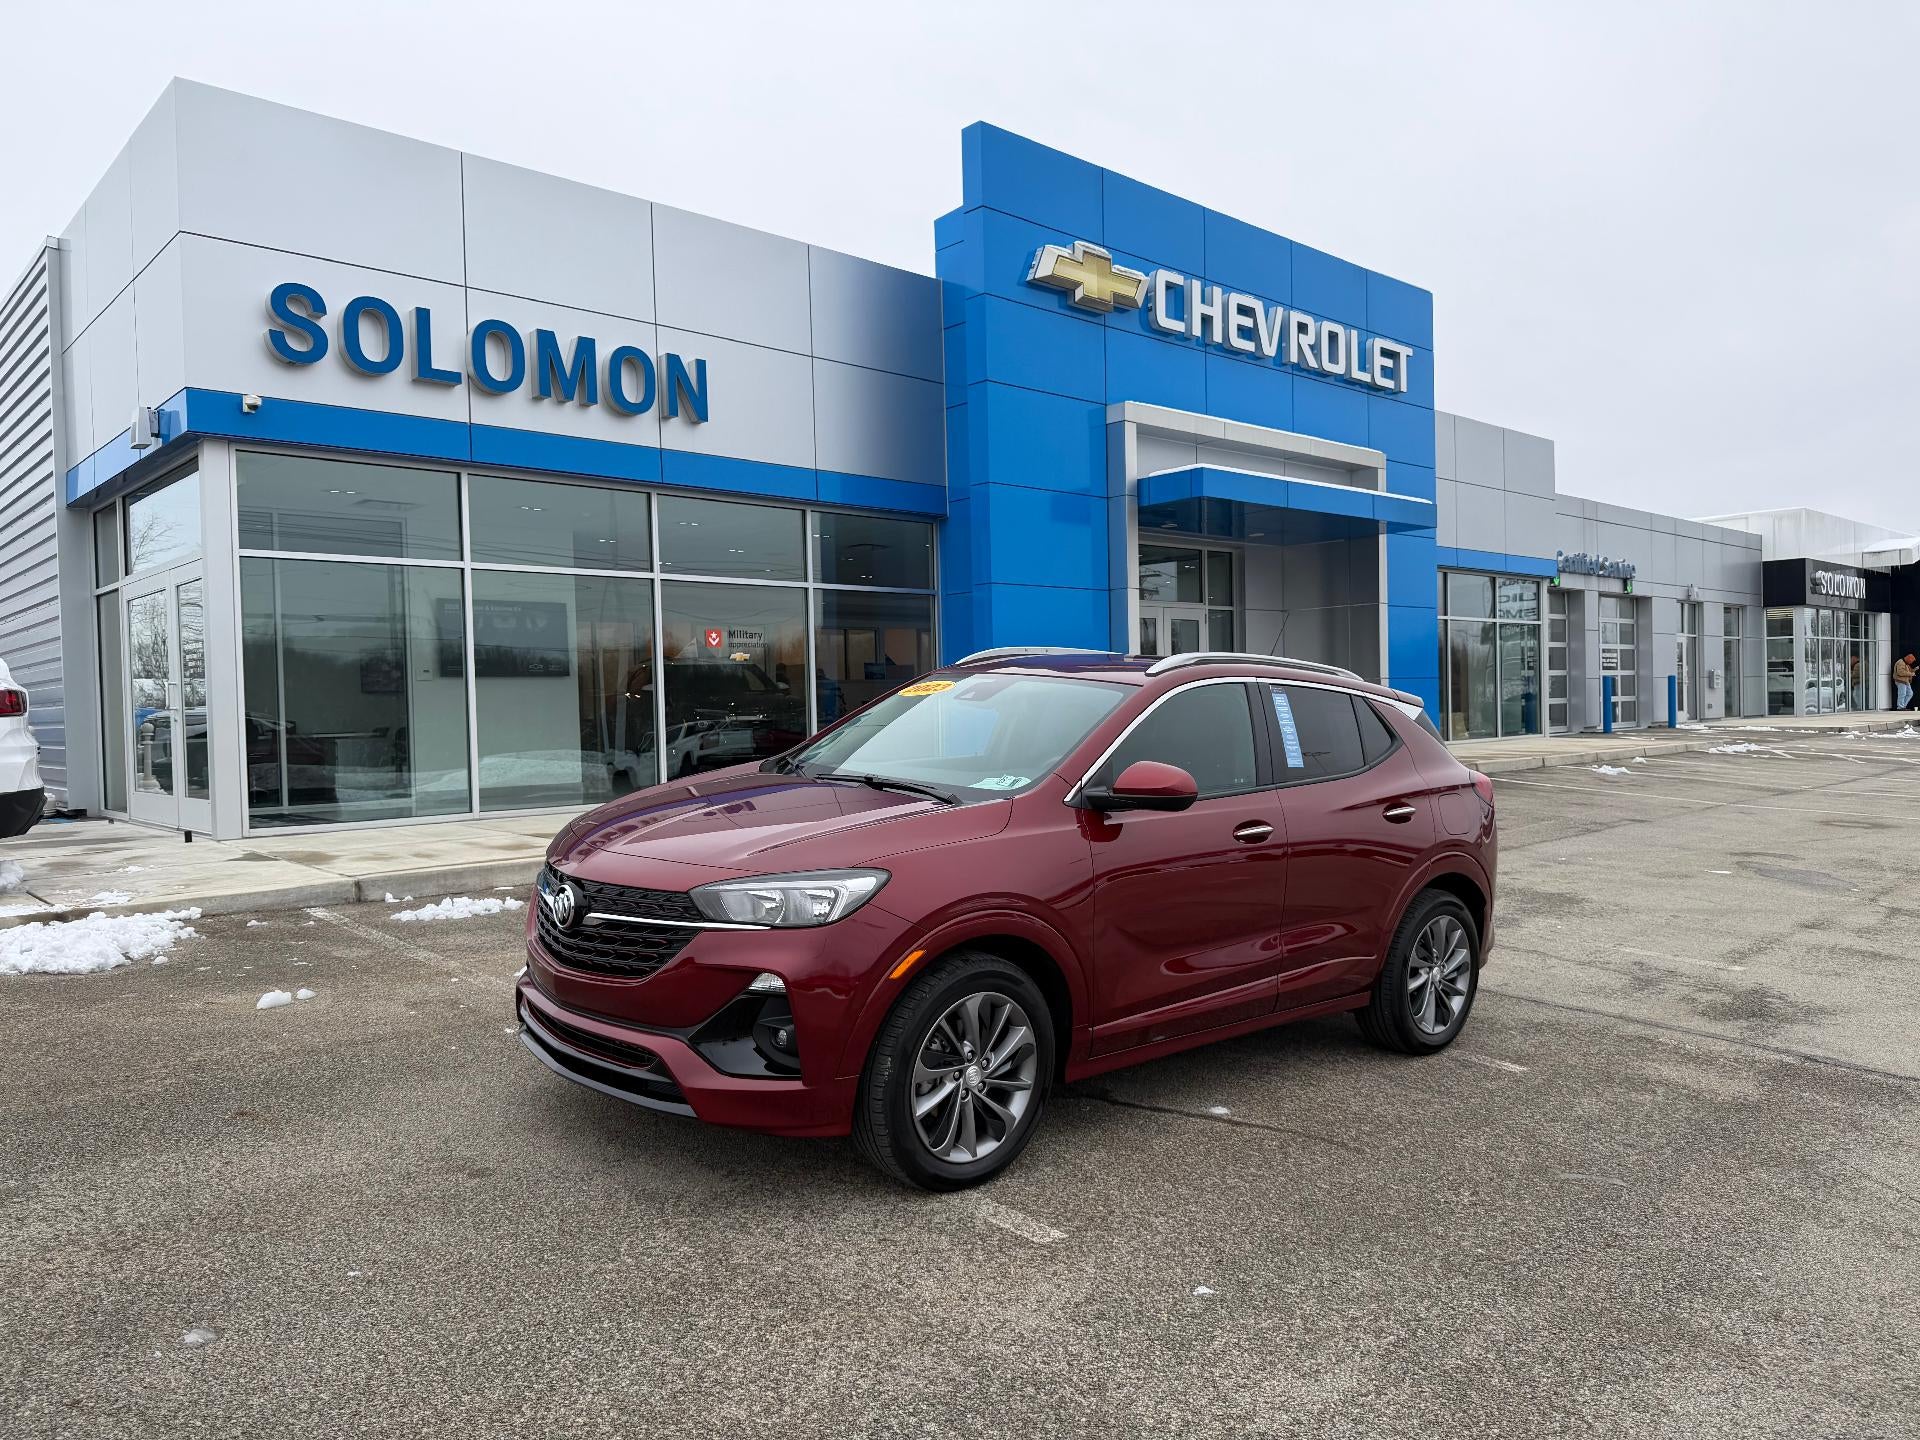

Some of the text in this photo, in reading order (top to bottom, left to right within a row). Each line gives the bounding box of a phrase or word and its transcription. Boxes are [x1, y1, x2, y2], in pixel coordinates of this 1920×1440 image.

[265, 282, 708, 424] SOLOMON
[1148, 268, 1412, 393] CHEVROLET
[1819, 570, 1867, 599] SOLOMON
[728, 629, 763, 641] Military
